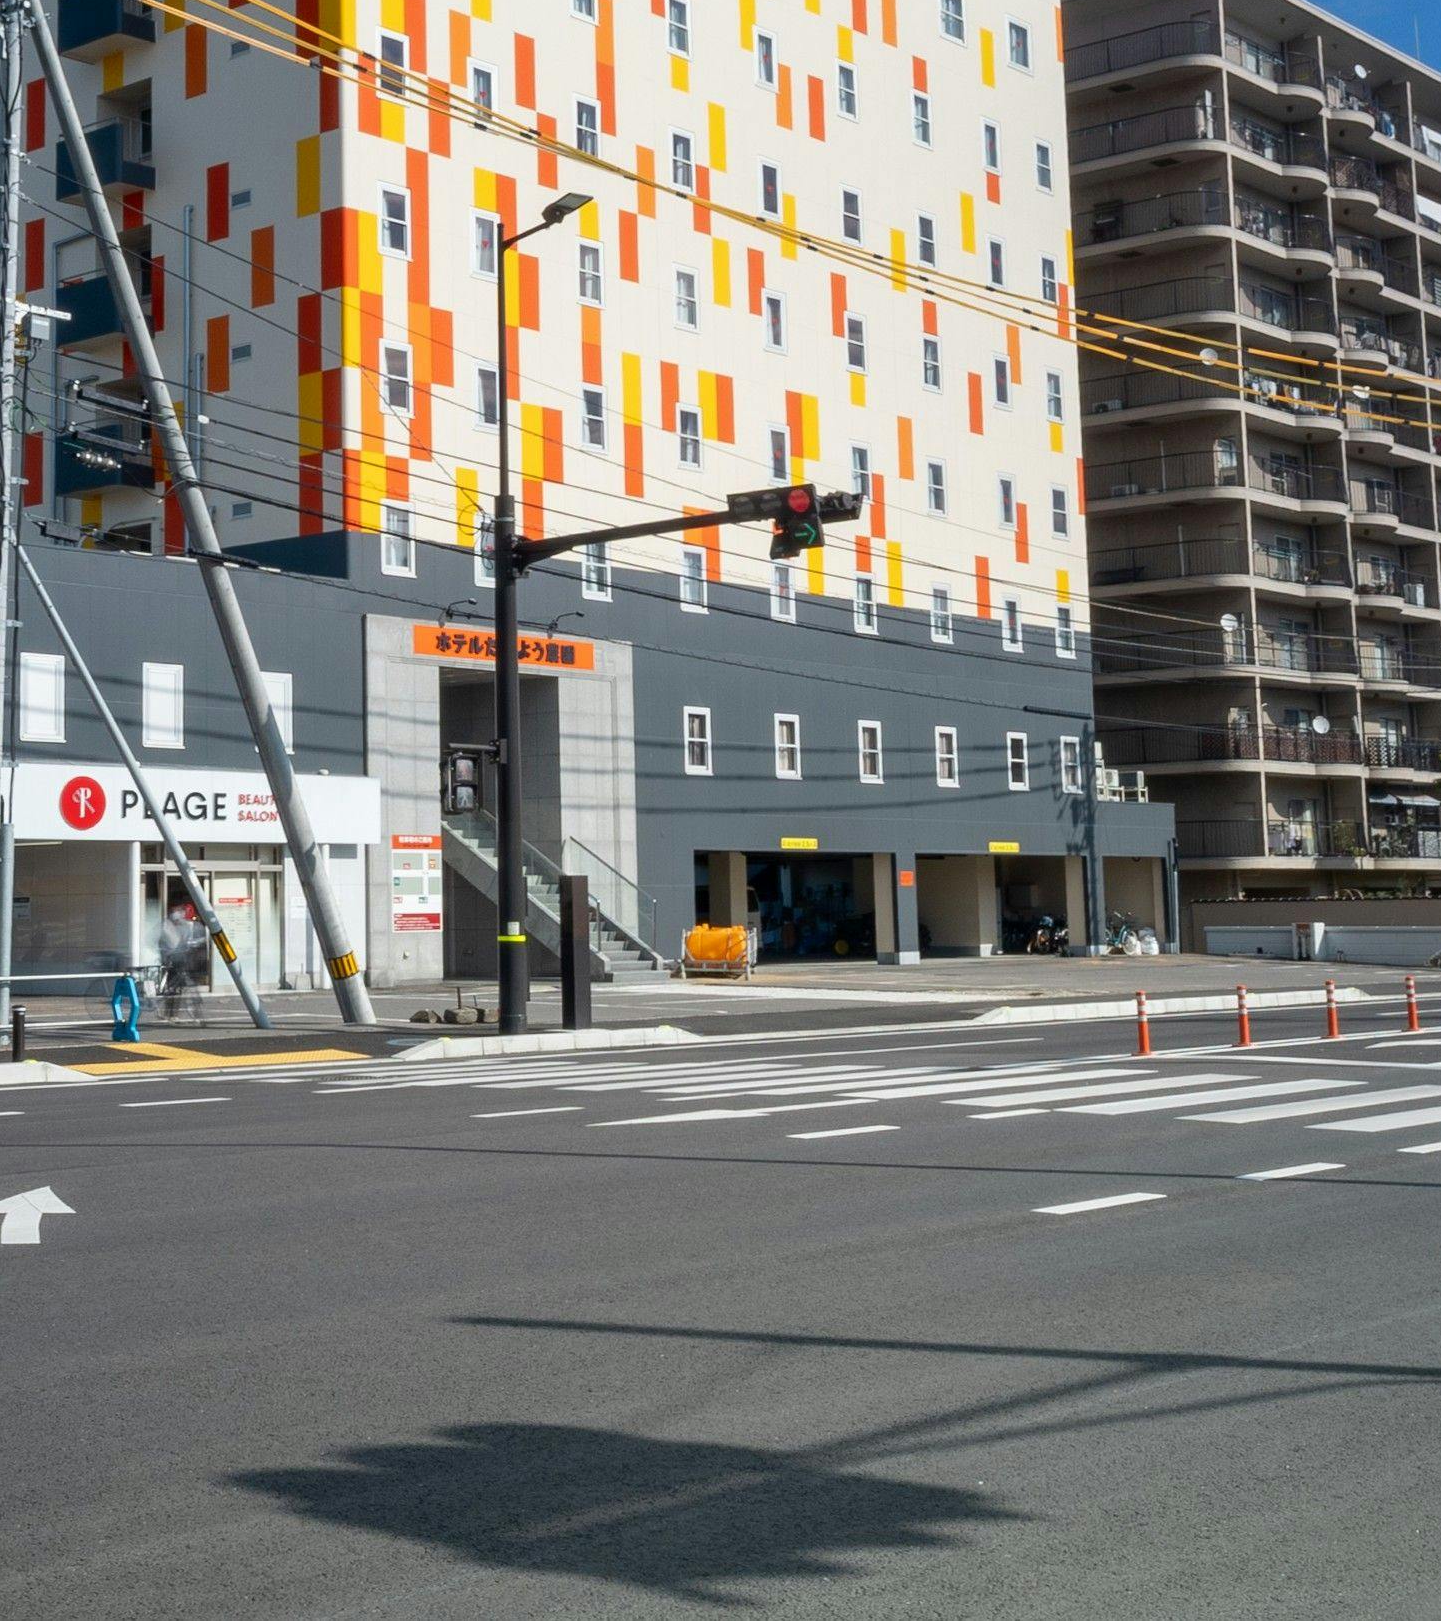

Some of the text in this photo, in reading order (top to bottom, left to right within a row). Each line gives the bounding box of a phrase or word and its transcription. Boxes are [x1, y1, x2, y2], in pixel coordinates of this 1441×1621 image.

[436, 632, 575, 665] ホテルたよう農園
[238, 794, 276, 805] BEAUT
[238, 810, 277, 821] SALON
